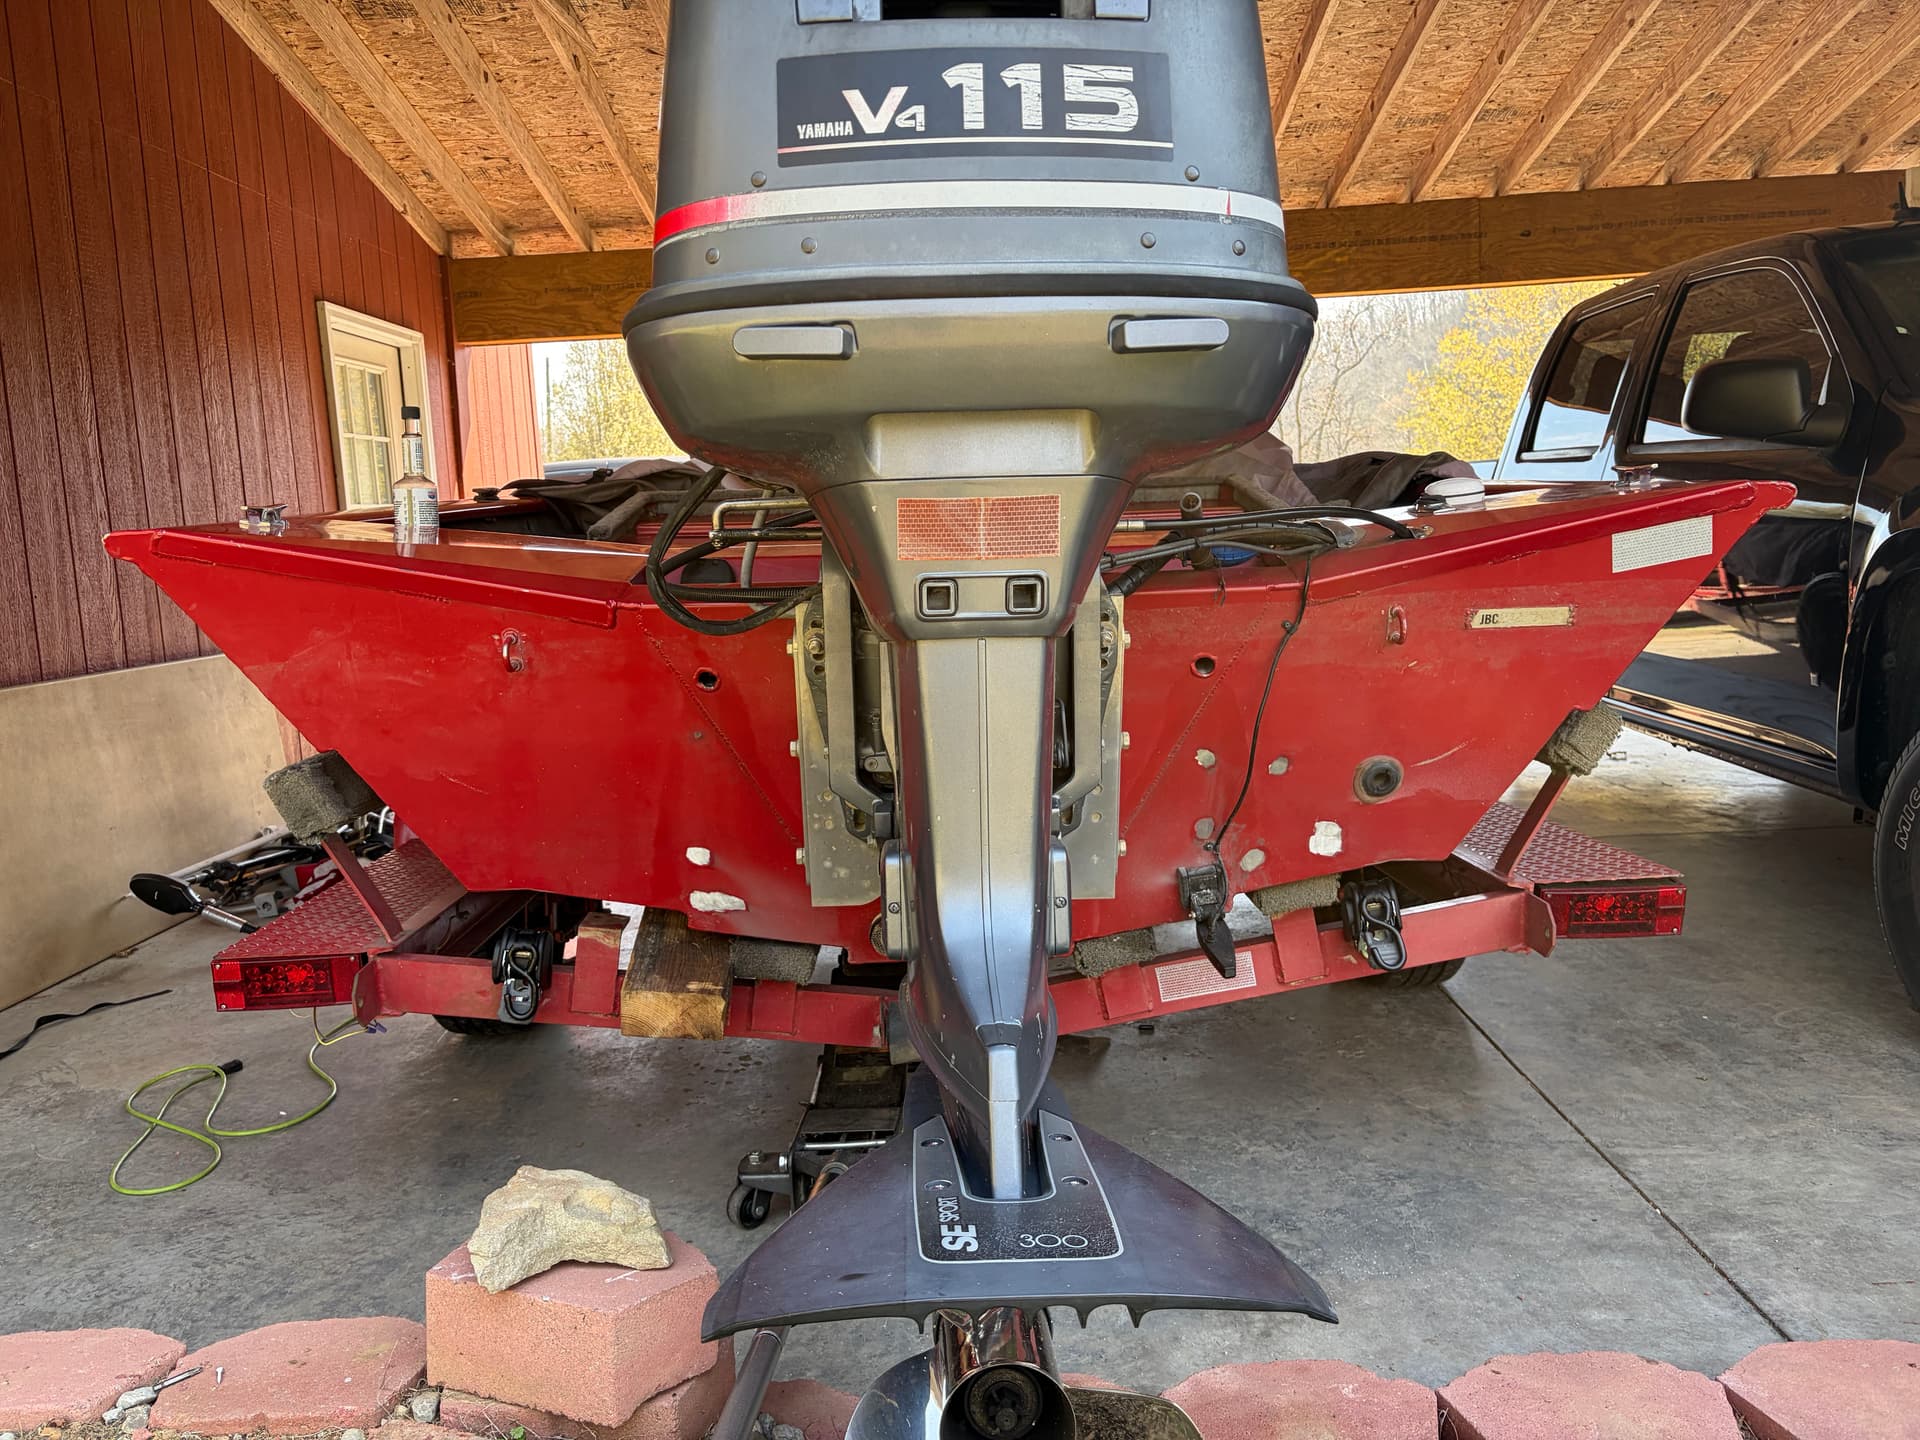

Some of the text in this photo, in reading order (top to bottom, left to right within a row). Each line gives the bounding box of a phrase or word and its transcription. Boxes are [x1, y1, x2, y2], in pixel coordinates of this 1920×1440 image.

[797, 63, 1139, 139] YAMAHA V4 115
[1479, 613, 1499, 625] JBC
[937, 1196, 979, 1252] SE SPORT
[1019, 1233, 1088, 1248] 300
